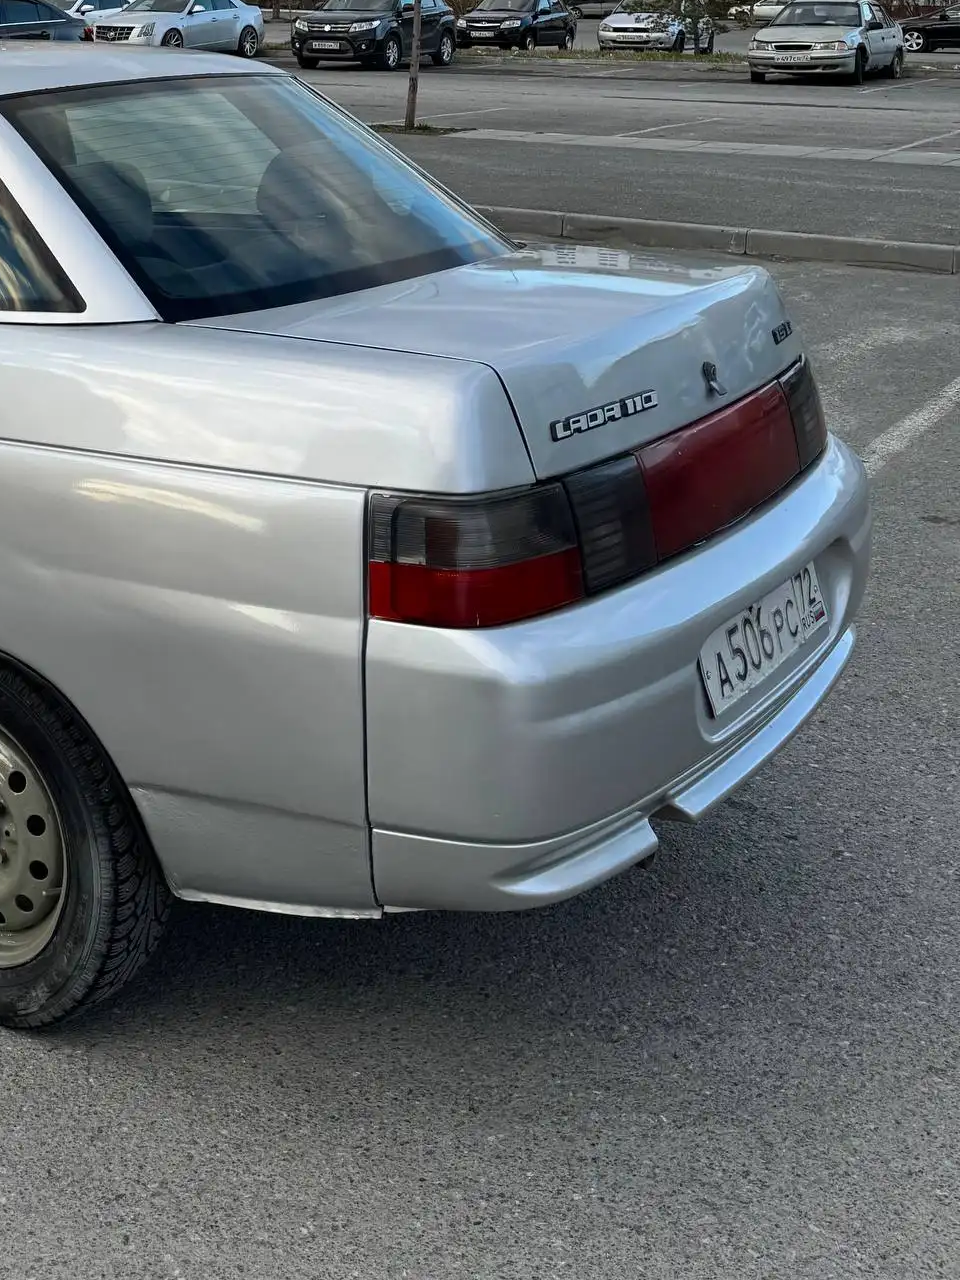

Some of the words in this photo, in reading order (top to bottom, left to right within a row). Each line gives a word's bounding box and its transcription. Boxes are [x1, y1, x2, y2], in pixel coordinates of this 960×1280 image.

[553, 402, 622, 440] LADA
[624, 390, 659, 415] 110
[794, 567, 816, 614] 72
[801, 610, 815, 631] RUS
